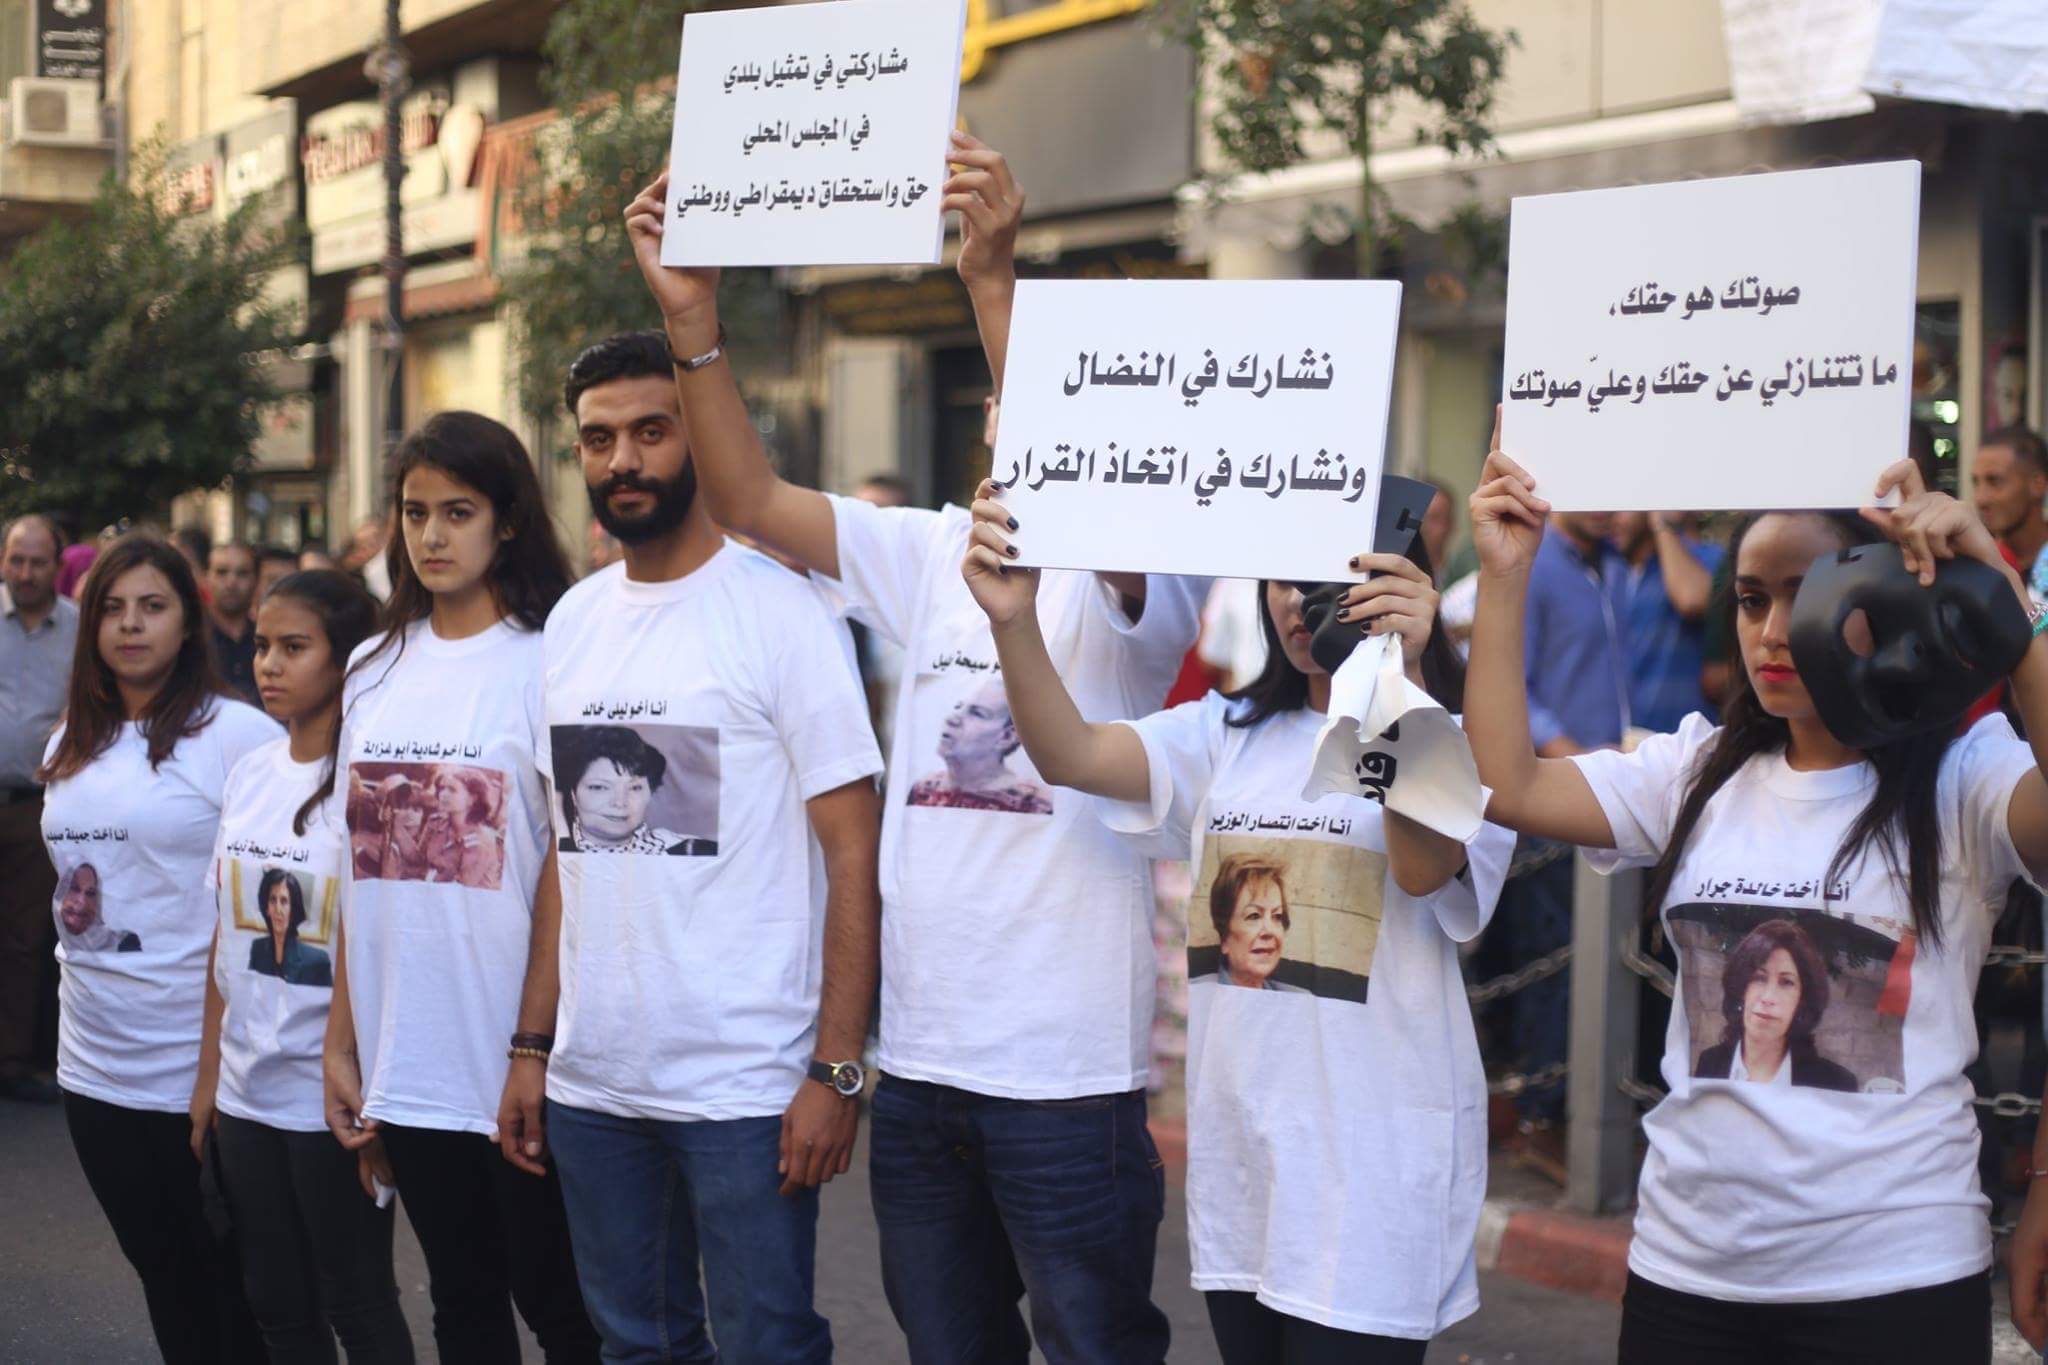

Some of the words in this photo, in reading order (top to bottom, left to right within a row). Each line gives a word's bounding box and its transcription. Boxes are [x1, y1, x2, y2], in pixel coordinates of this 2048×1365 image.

[724, 62, 761, 94] بلدي
[764, 53, 809, 88] تمثيل
[814, 53, 833, 90] في
[836, 47, 908, 89] مشاركتي
[743, 119, 789, 155] المحلي
[792, 116, 847, 148] المجلس
[850, 113, 870, 151] في
[677, 183, 730, 218] ووطني
[733, 179, 815, 217] ديمقراطي
[819, 177, 898, 208] واستحقاق
[902, 176, 928, 208] حق
[1681, 285, 1714, 320] هو
[1720, 275, 1800, 315] صوتك
[1064, 350, 1175, 396] النضال
[1181, 348, 1218, 407] في
[1226, 347, 1333, 398] نشارك
[1652, 361, 1709, 394] حقك
[1716, 363, 1753, 401] عن
[1760, 354, 1863, 407] تتنازلي
[1873, 355, 1897, 385] ما
[1510, 369, 1582, 407] صوتك
[1003, 443, 1095, 491] القرار
[1103, 441, 1188, 485] اتخاذ
[1194, 447, 1232, 507] في
[1240, 447, 1366, 503] ونشارك
[1209, 811, 1250, 832] الوزير
[1250, 814, 1297, 832] انتصار
[1296, 815, 1327, 832] أخت
[1328, 818, 1352, 836] أنا
[1695, 877, 1732, 899] جرار
[1734, 877, 1781, 898] خالدة
[1783, 879, 1820, 899] أخت
[1823, 881, 1850, 901] أنا
